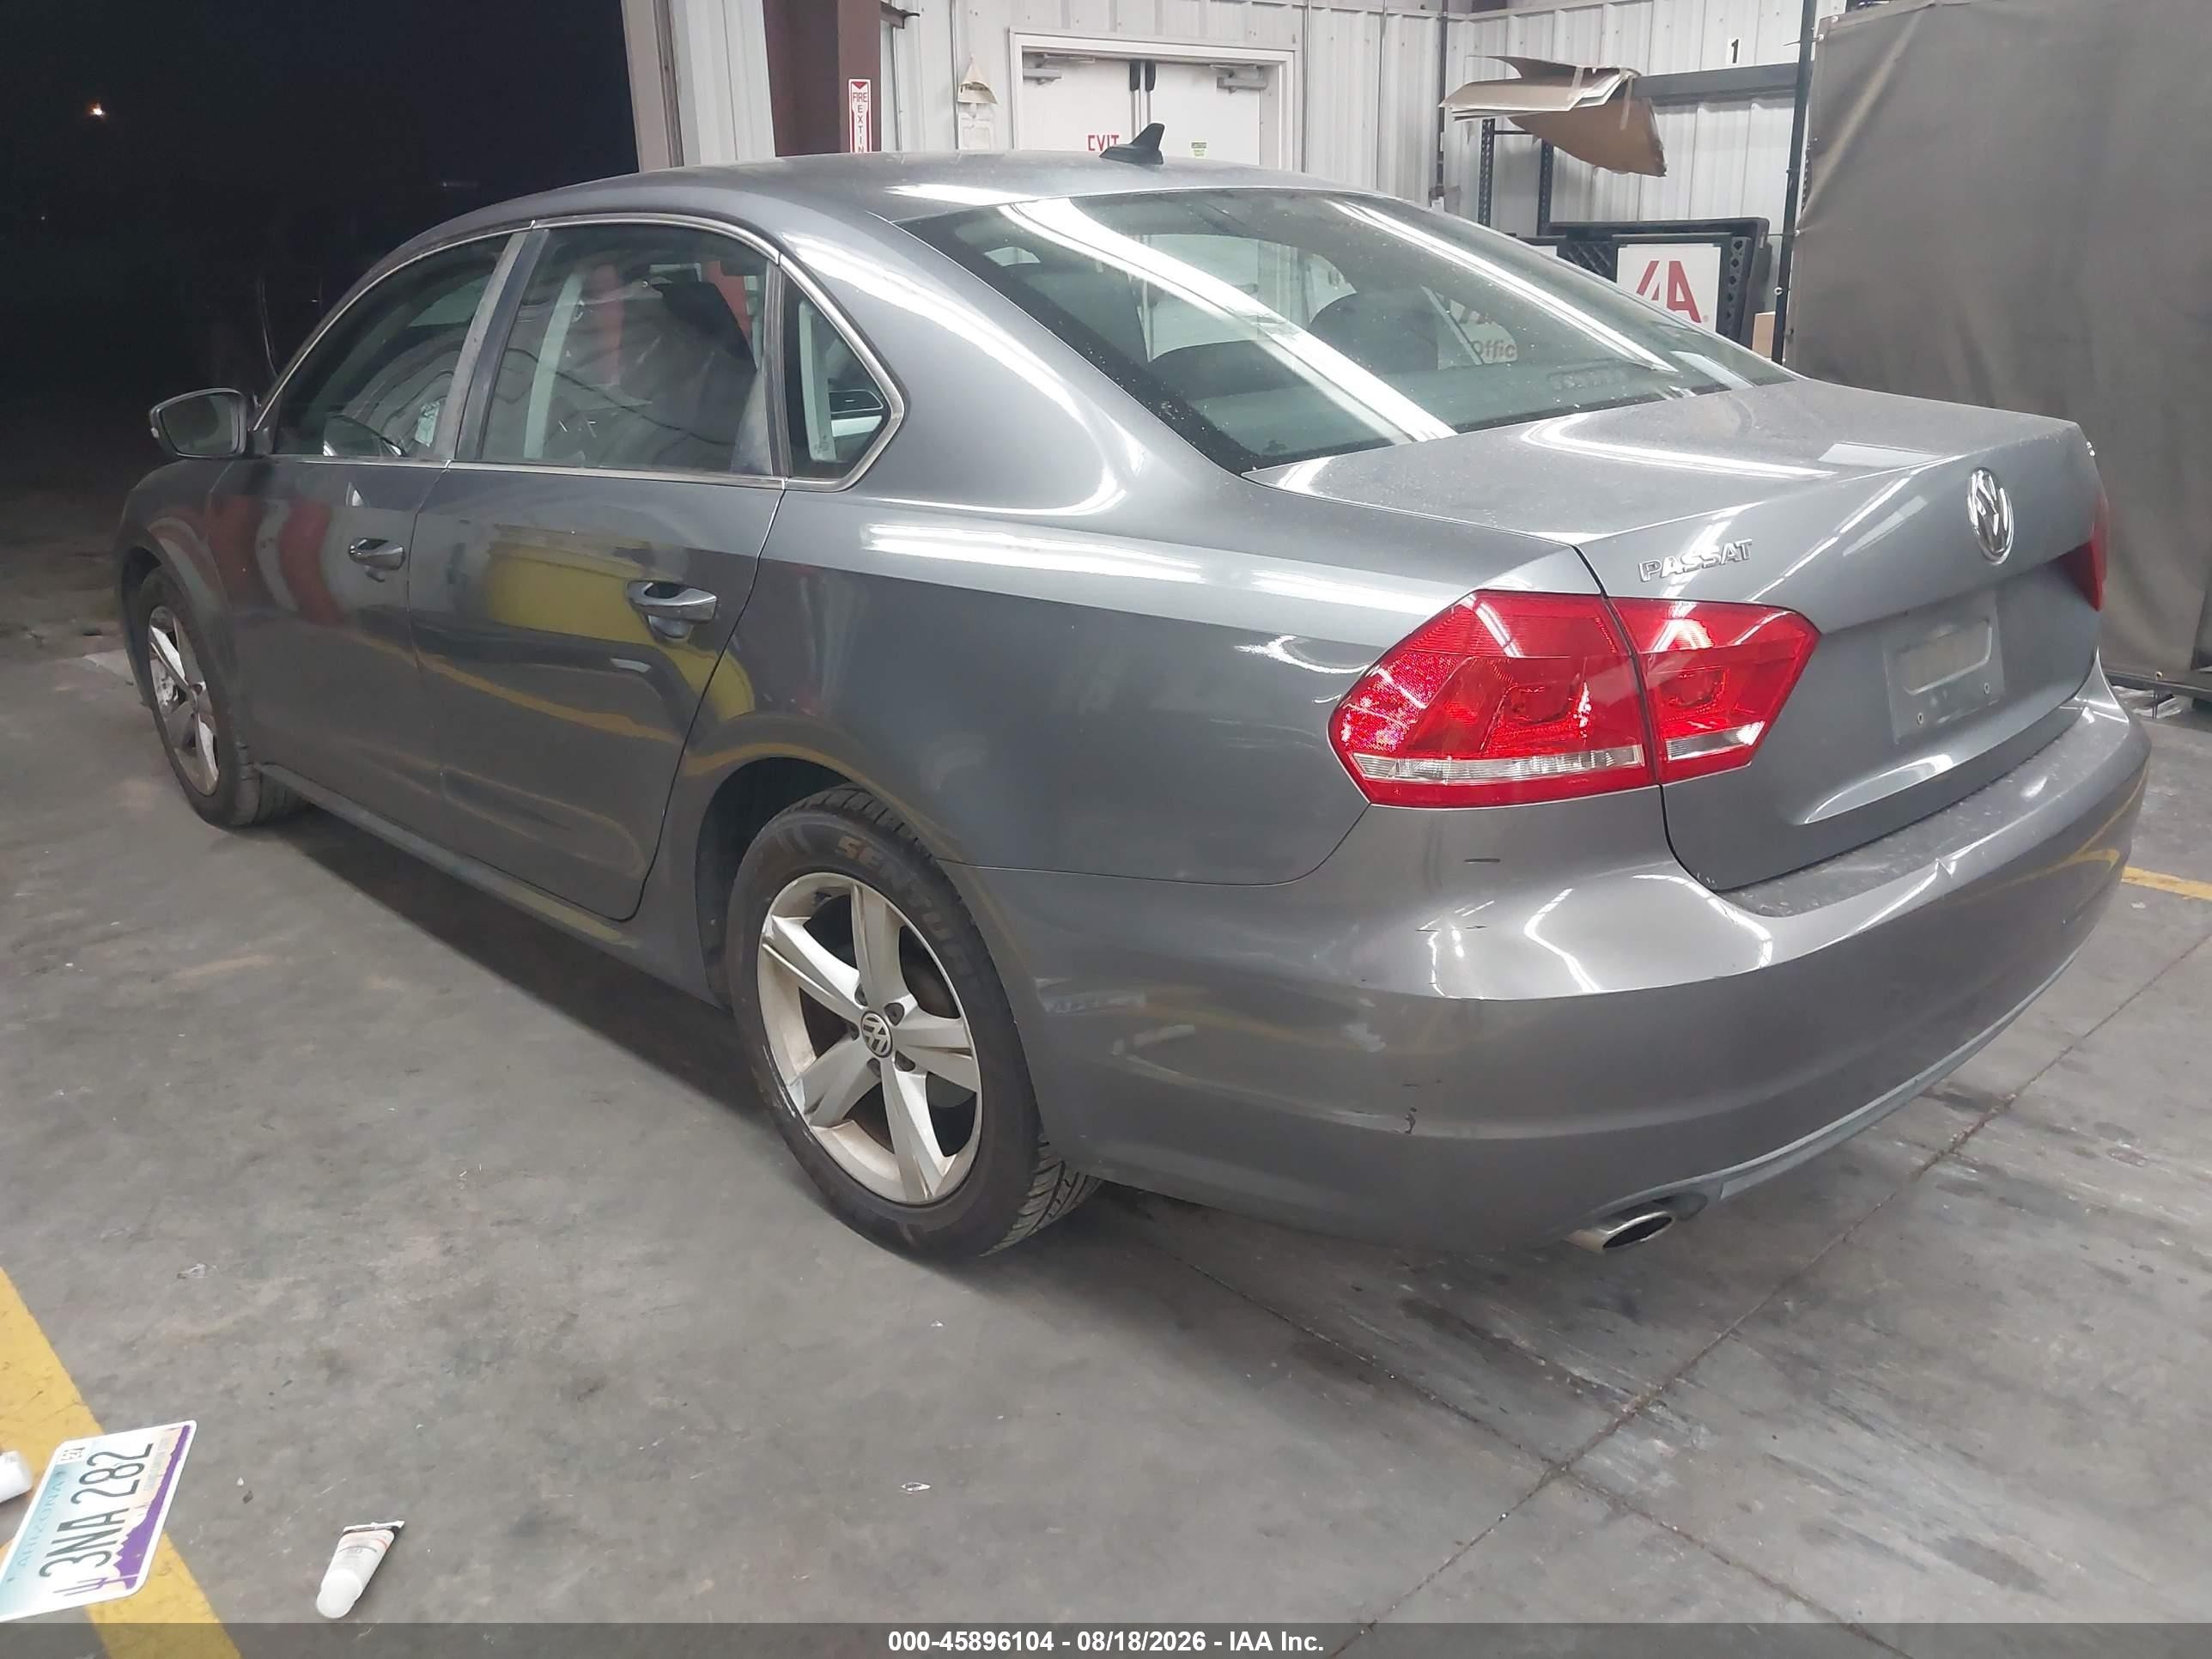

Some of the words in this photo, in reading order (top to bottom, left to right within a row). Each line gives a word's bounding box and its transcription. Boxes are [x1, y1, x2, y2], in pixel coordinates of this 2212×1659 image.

[1731, 39, 1739, 64] 1
[853, 92, 867, 102] FIRE
[1638, 538, 1753, 582] PASSAT
[70, 1443, 154, 1504] 282
[39, 1508, 130, 1577] 3NA
